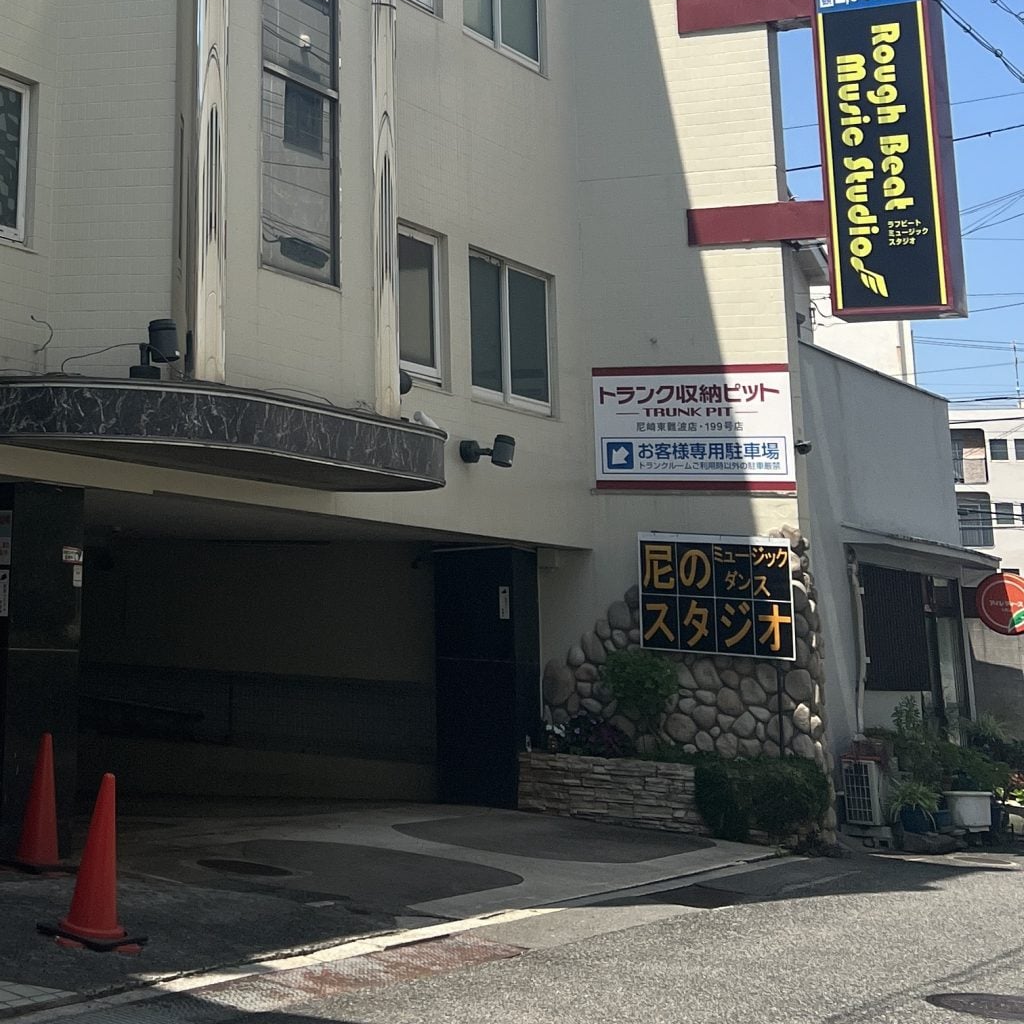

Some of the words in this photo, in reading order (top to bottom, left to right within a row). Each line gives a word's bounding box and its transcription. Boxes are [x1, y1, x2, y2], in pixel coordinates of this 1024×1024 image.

[866, 22, 907, 125] Rough
[836, 53, 871, 146] Music
[880, 134, 915, 211] Beat
[843, 157, 880, 258] Studio
[887, 219, 921, 228] ラフビート
[888, 227, 928, 237] ミュージック
[888, 237, 916, 246] スタジオ
[599, 383, 780, 405] トランク収納ピット
[642, 407, 702, 417] TRUNK
[706, 407, 733, 417] PIT
[638, 442, 780, 461] お客様専用駐車場
[643, 544, 711, 590] 尼の
[713, 546, 788, 569] ミュージック
[724, 570, 771, 597] ダンス
[644, 599, 792, 652] スタジオ
